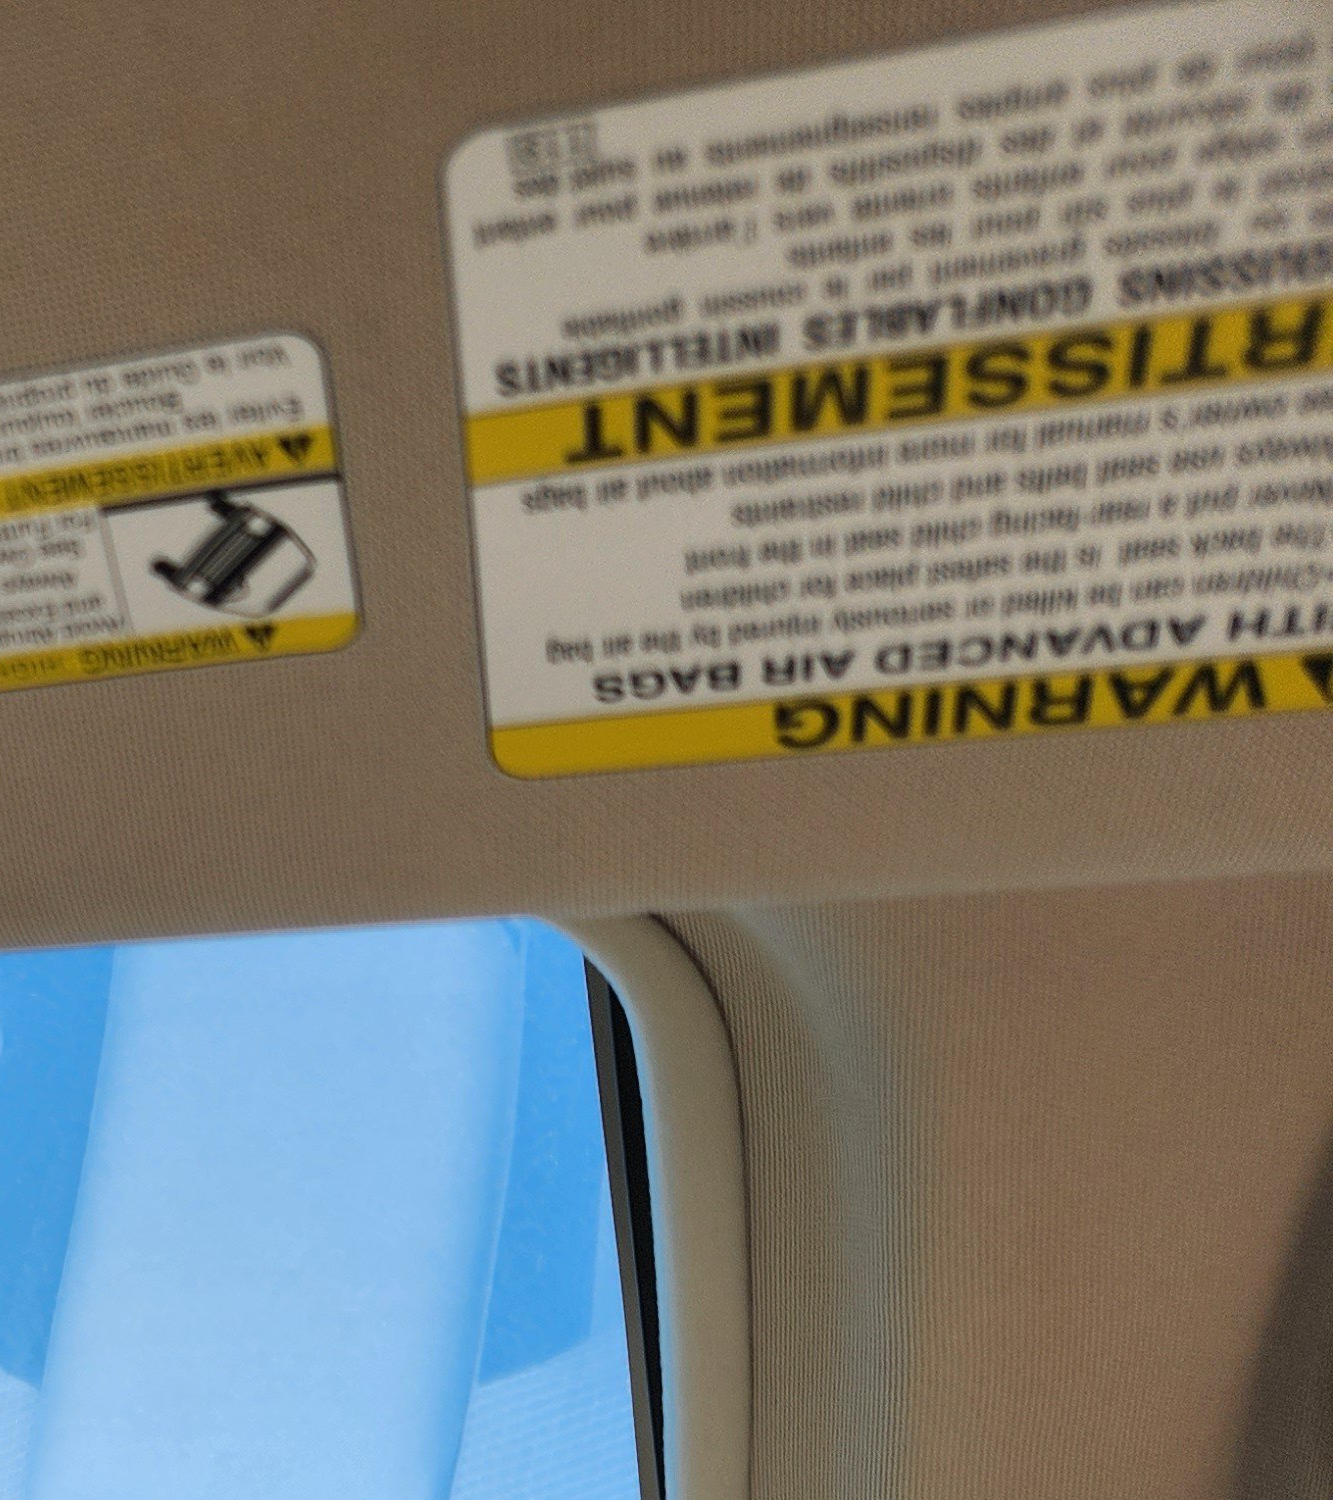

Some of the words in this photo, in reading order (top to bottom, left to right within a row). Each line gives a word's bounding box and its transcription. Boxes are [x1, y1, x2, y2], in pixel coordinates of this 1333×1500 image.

[803, 277, 1092, 353] GONFLABLES
[495, 323, 781, 400] INTELLIGENTS
[874, 615, 1206, 676] ADVANCED
[1227, 603, 1333, 643] ITH
[80, 628, 240, 677] WARNING
[761, 650, 856, 688] AIR
[591, 659, 742, 704] BAGS
[772, 659, 1268, 752] WARNING
